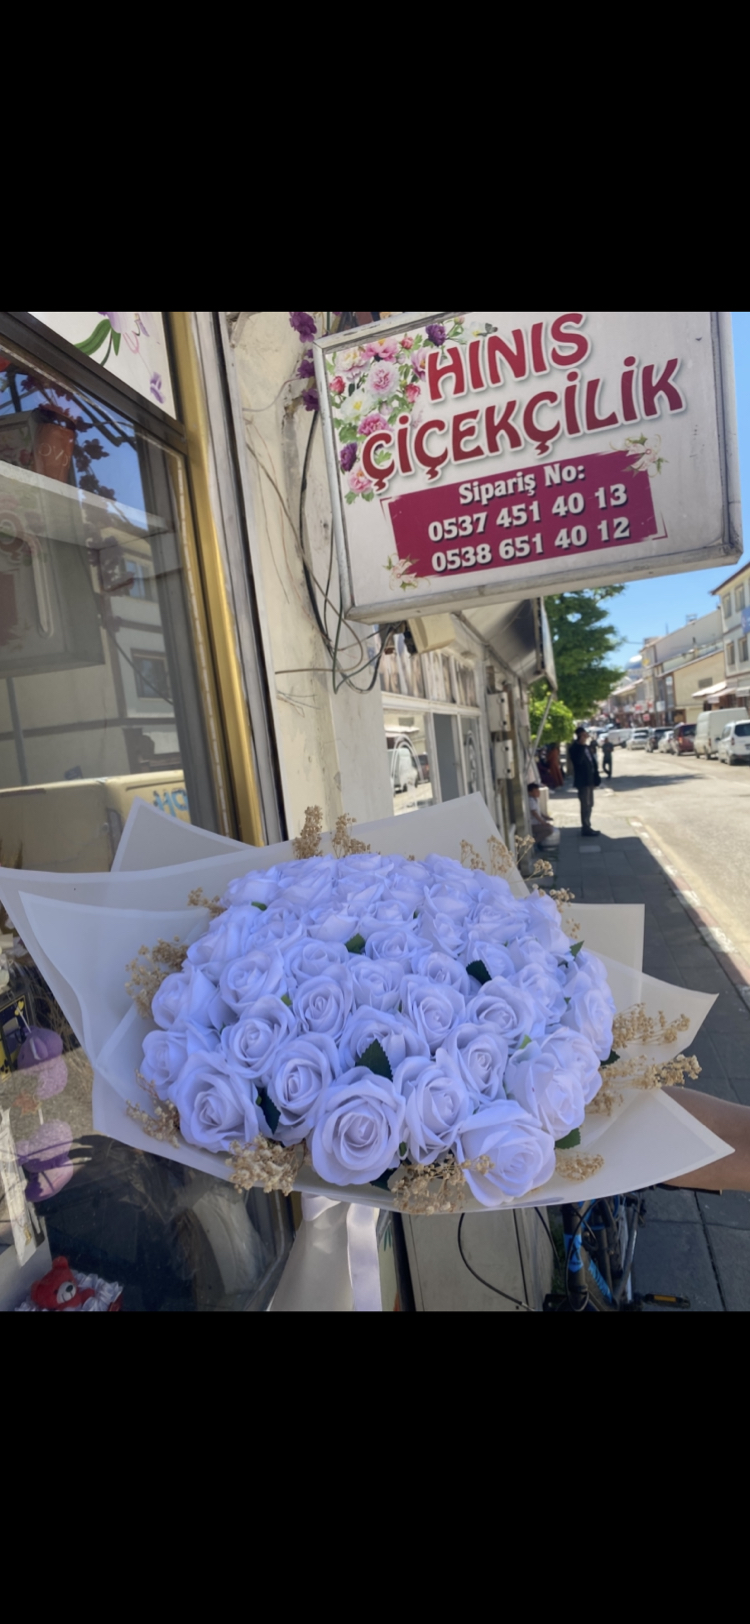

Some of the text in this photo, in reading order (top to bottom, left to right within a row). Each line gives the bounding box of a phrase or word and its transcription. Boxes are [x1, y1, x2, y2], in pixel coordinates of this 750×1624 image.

[427, 313, 590, 401] HINIS
[361, 356, 684, 492] ÇİÇEKÇİLİK
[428, 483, 627, 542] 0537 451 40 13
[458, 463, 586, 505] Sipariş No:
[431, 517, 630, 573] 0538 651 40 12
